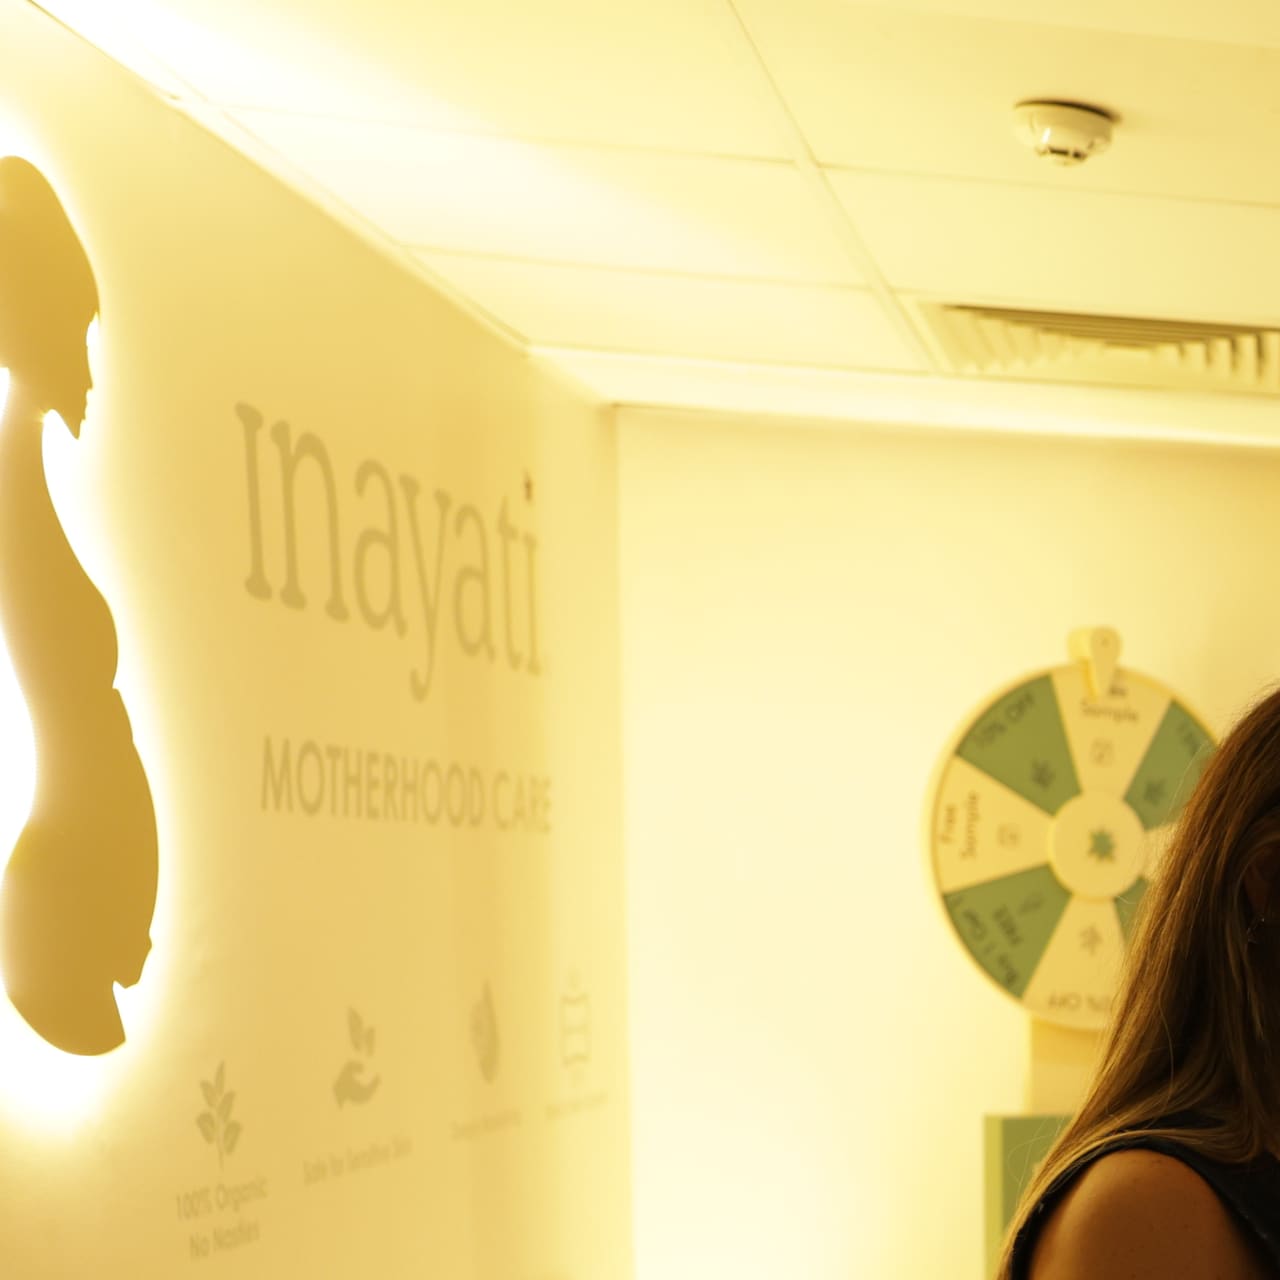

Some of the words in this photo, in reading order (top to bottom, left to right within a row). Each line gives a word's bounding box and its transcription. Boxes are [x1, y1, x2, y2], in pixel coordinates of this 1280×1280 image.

[261, 736, 486, 829] MOTHERHOOD
[492, 770, 553, 834] CARE
[215, 1175, 268, 1213] Organic
